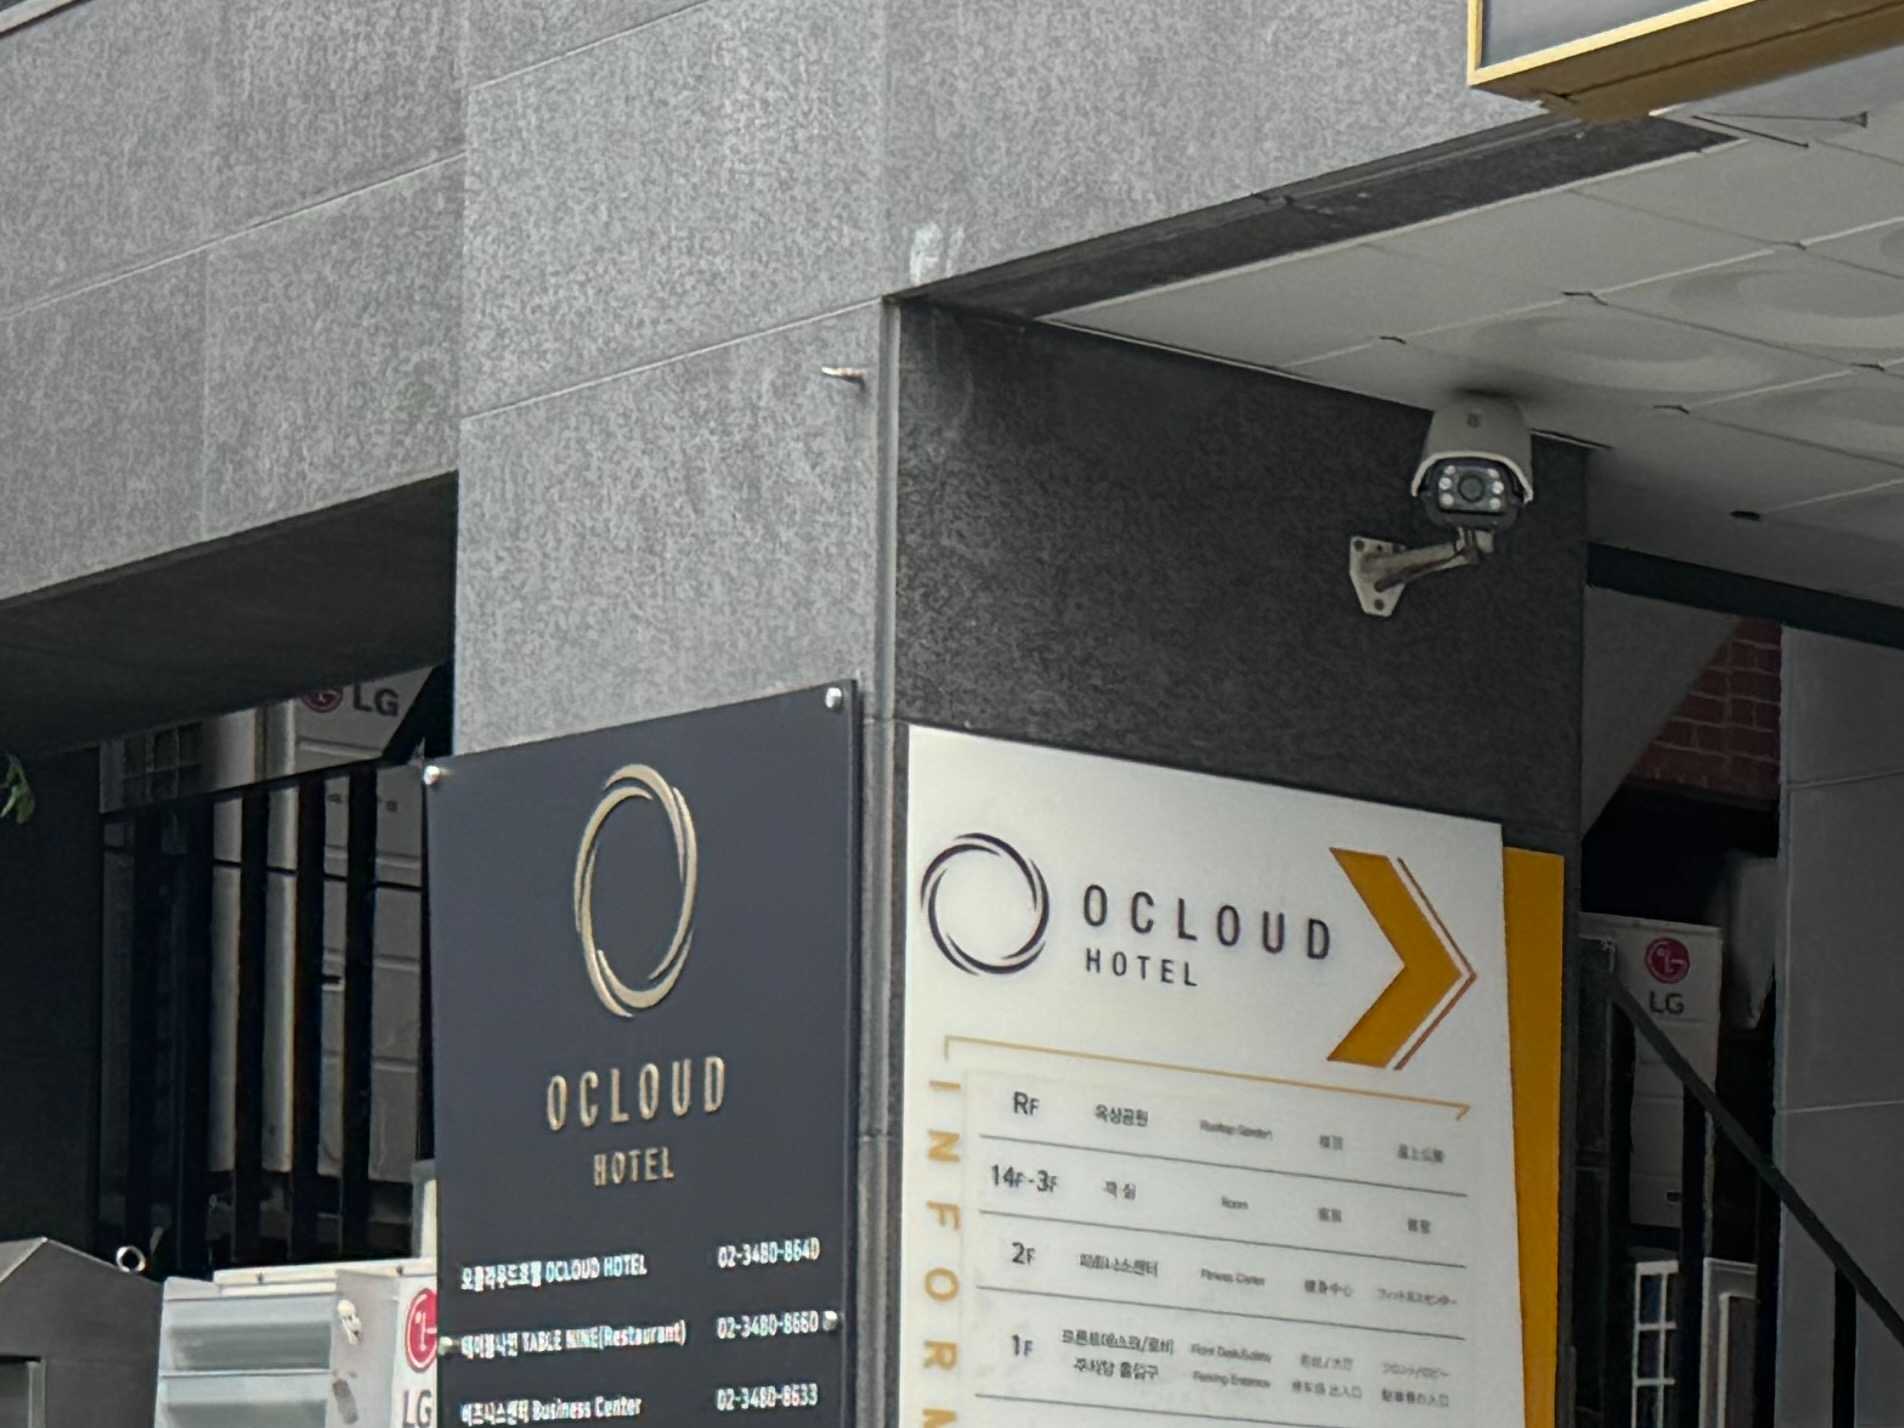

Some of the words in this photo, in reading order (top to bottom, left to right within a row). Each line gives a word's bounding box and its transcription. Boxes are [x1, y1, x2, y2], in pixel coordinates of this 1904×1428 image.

[1081, 883, 1332, 961] OCLOUD
[1085, 947, 1198, 987] HOTEL
[1649, 989, 1685, 1015] LG
[546, 1055, 726, 1132] OCLOUD
[1012, 1091, 1040, 1116] RF
[594, 1146, 675, 1187] HOTEL
[717, 1236, 820, 1268] 02-3480-8640
[1011, 1241, 1036, 1265] 2F
[545, 1256, 600, 1283] OCLOUD
[603, 1253, 648, 1277] HOTEL
[1011, 1334, 1033, 1357] 1F
[531, 1397, 592, 1422] Business
[594, 1395, 643, 1418] Center
